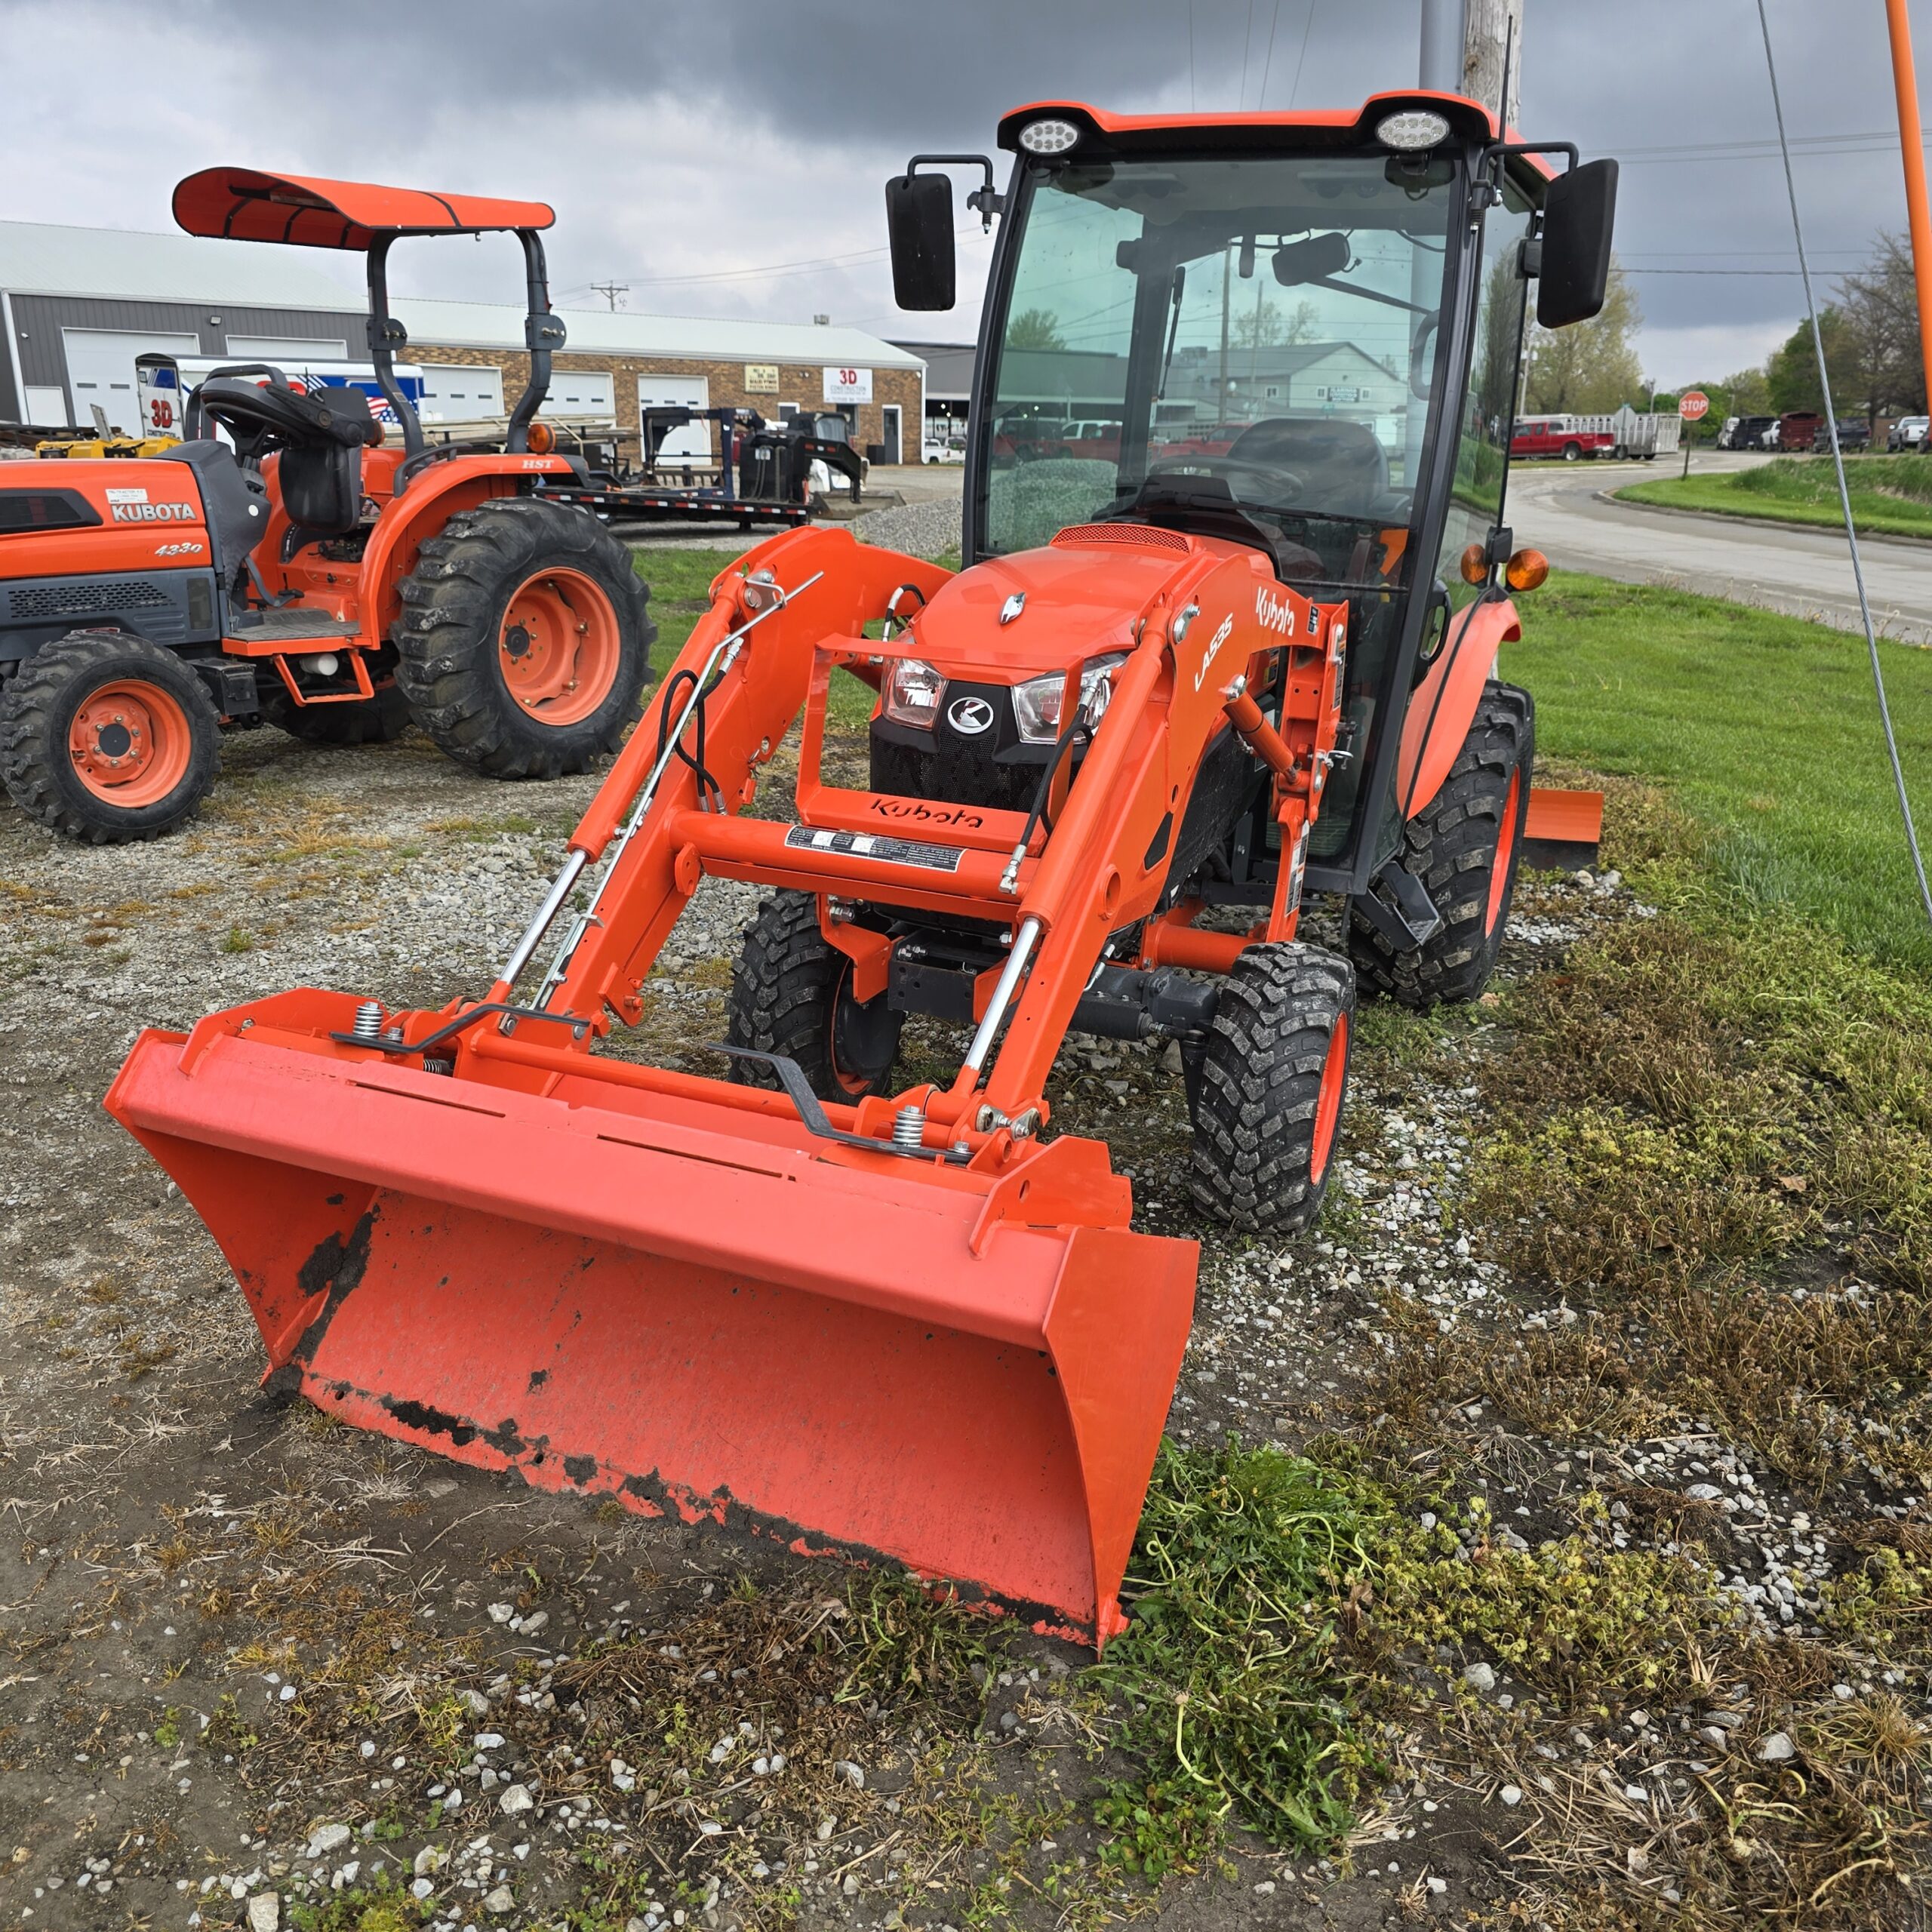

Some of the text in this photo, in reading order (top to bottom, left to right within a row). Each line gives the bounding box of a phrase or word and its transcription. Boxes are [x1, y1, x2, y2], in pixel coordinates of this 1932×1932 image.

[839, 370, 857, 384] 3D
[151, 399, 173, 428] 3D
[1681, 399, 1708, 412] STOP
[522, 459, 555, 469] HST
[111, 503, 197, 522] KUBOTA
[154, 542, 203, 557] 4330
[1255, 586, 1295, 636] Kubota
[1195, 612, 1233, 692] LA535
[870, 798, 983, 828] Kubota
